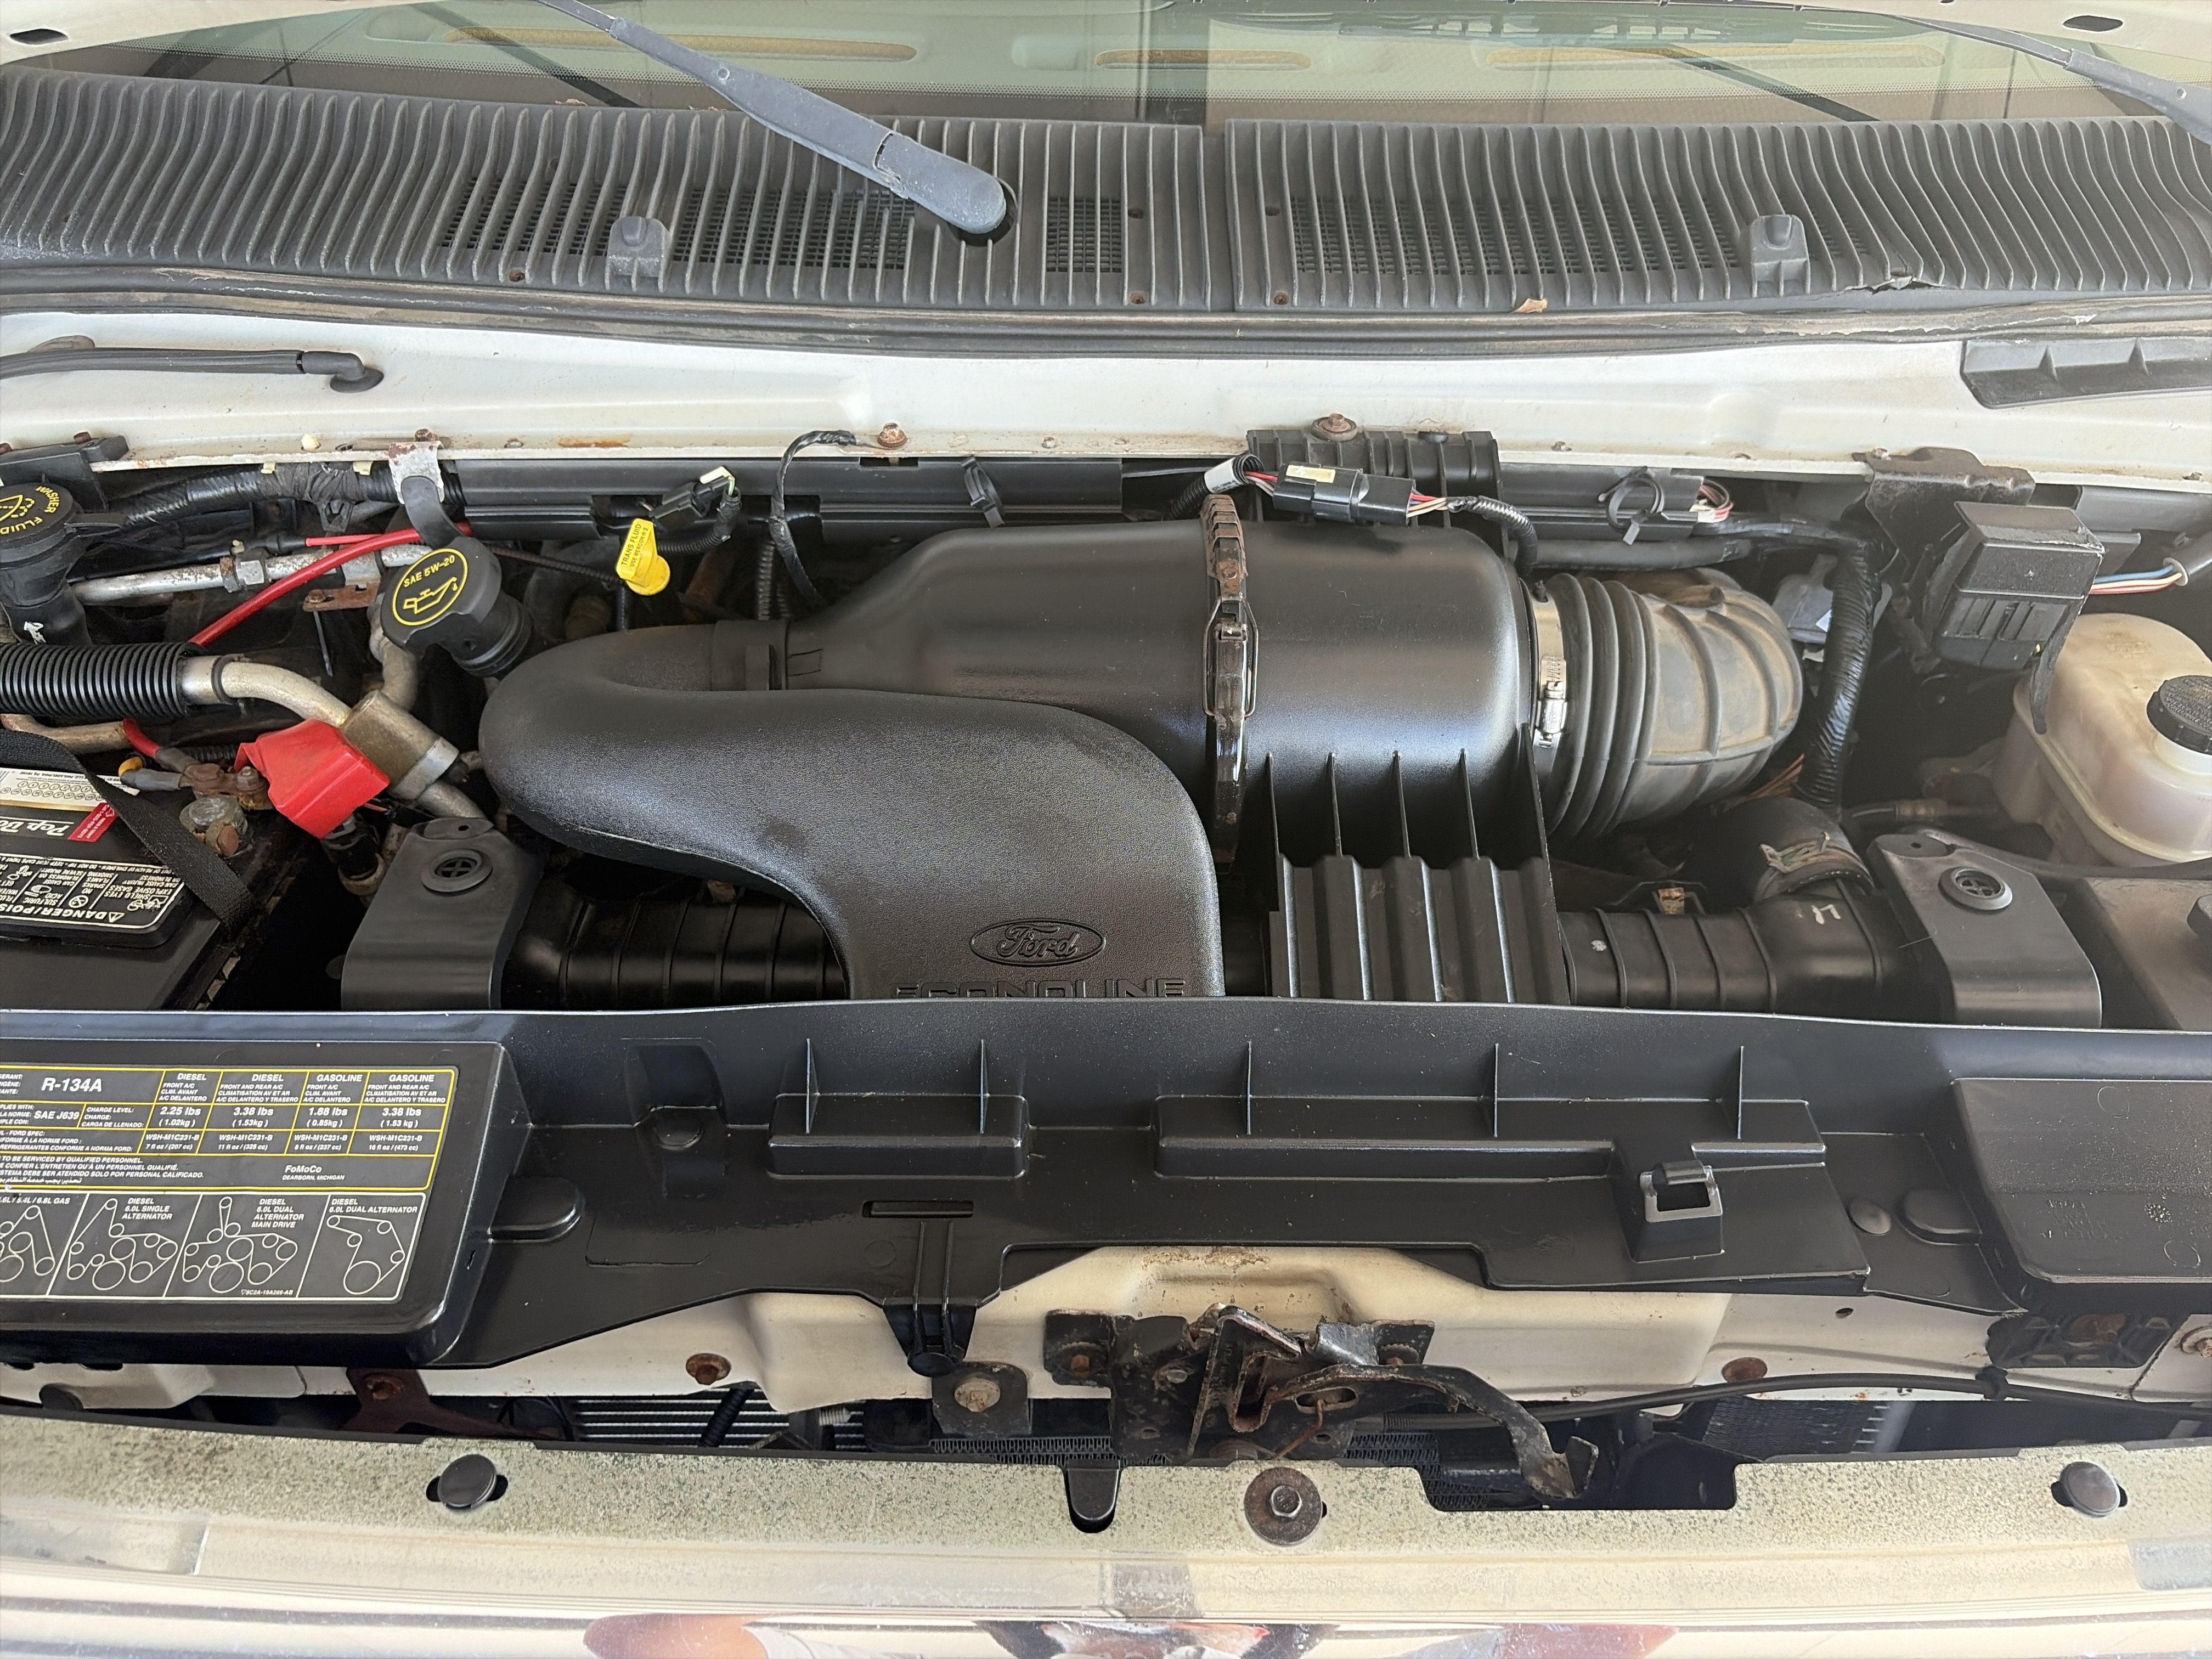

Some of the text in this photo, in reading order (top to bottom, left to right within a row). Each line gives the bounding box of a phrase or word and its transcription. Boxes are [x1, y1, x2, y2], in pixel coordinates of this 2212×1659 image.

[35, 486, 59, 513] WASHER
[0, 517, 43, 534] FLUID
[621, 524, 642, 566] TRANS FLUID
[404, 555, 455, 587] SAE 5W-20
[23, 897, 58, 906] SULFURIC
[997, 924, 1080, 957] Ford
[317, 1074, 363, 1082] GASOLINE
[389, 1074, 435, 1082] GASOLINE
[41, 1077, 102, 1092] R-134A
[33, 1111, 80, 1120] SAE J639
[160, 1107, 201, 1116] 2.25 lbs
[233, 1107, 274, 1116] 3.38 lbs
[309, 1107, 348, 1116] 1.88 lbs
[382, 1108, 422, 1116] 3.38 lbs
[285, 1165, 322, 1173] FoMoCo
